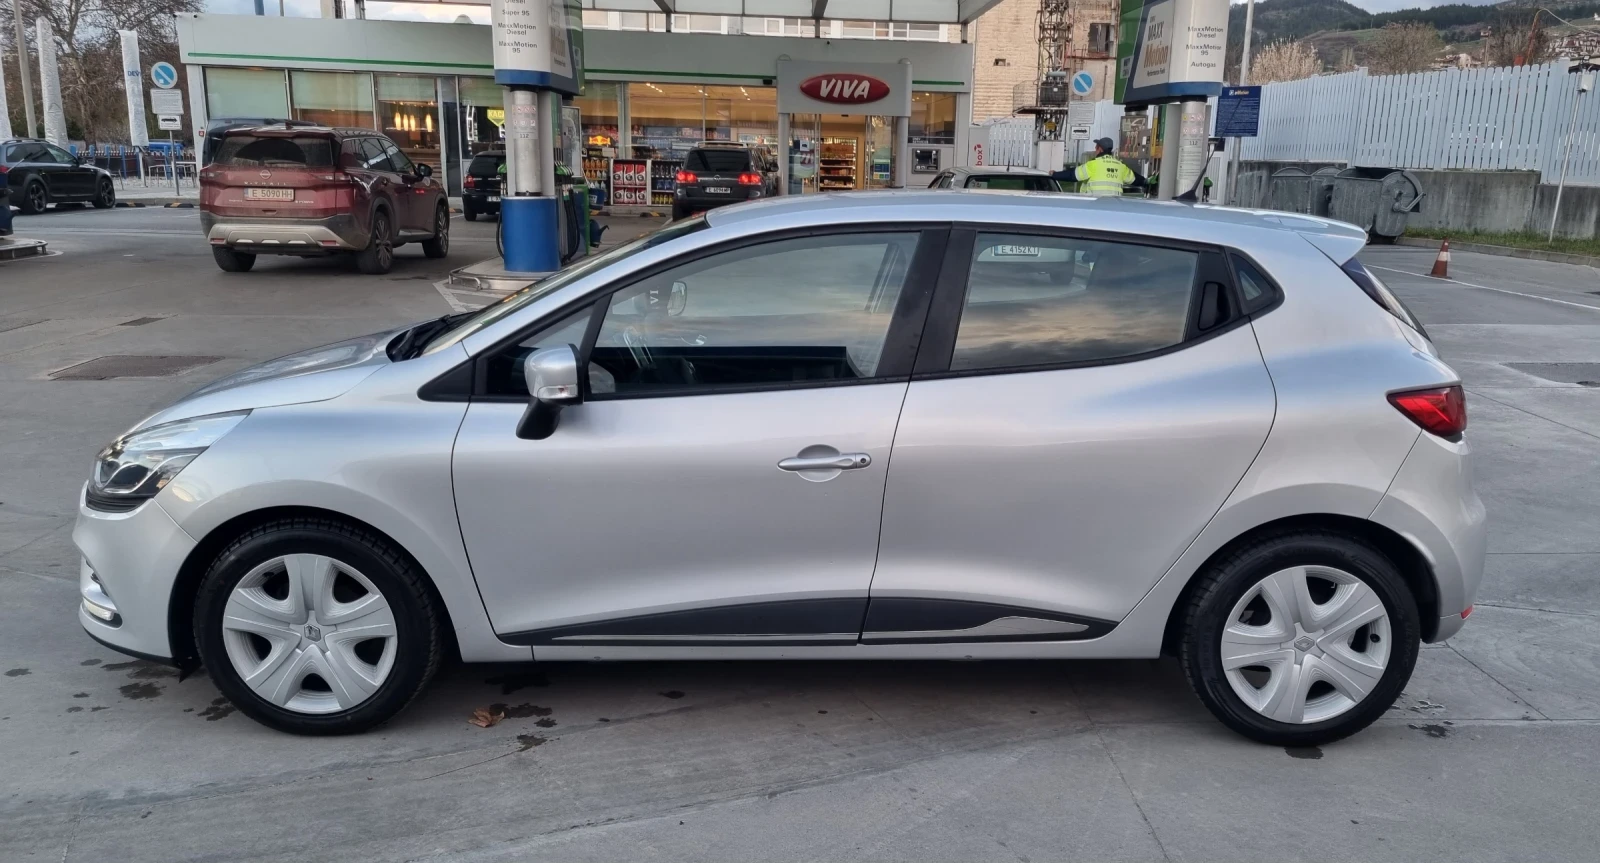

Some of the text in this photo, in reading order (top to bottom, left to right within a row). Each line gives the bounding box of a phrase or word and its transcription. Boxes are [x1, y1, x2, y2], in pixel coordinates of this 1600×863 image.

[498, 22, 537, 30] MaxxMotion
[1187, 25, 1224, 33] MaxxMotion
[1185, 43, 1222, 51] MaxxMotion
[1190, 61, 1216, 69] Autogas
[820, 78, 870, 99] VIVA
[975, 149, 983, 166] box
[252, 189, 258, 198] E
[1001, 246, 1007, 254] E
